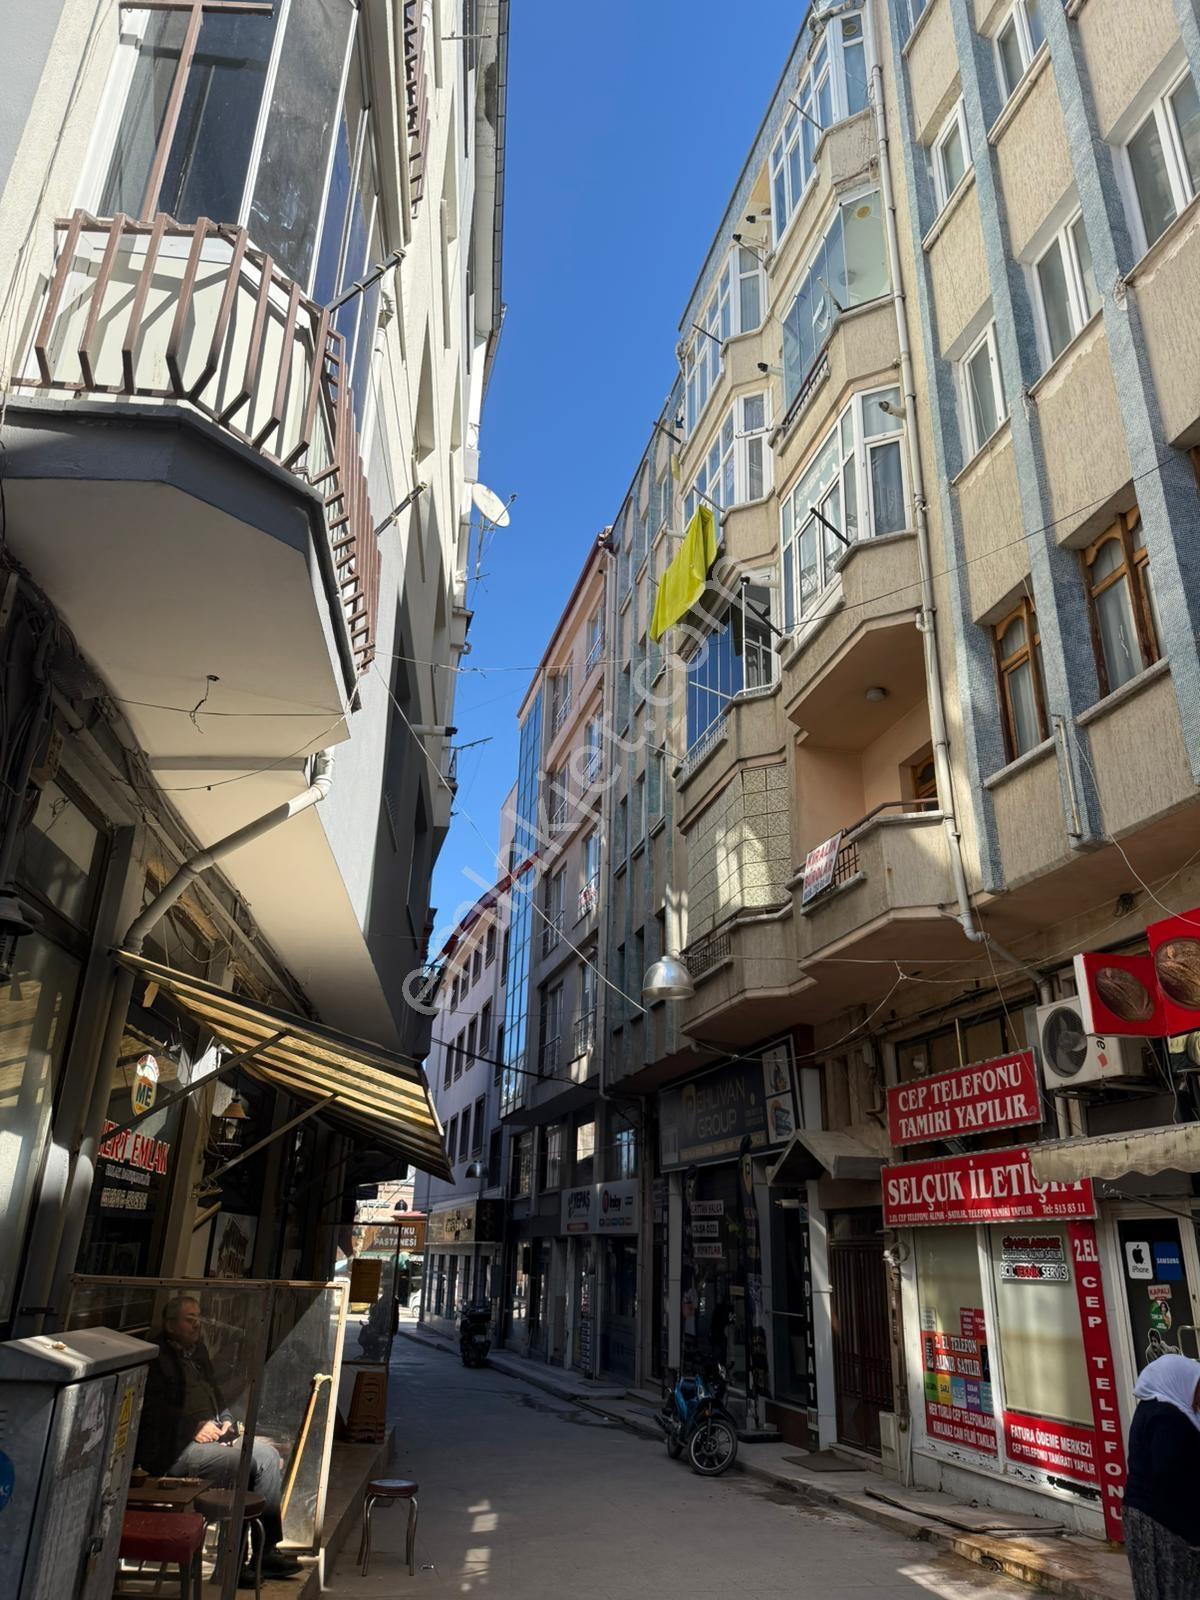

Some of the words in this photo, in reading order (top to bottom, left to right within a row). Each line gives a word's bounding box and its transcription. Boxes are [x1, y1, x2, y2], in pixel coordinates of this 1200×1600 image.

[136, 1083, 153, 1107] ME
[898, 1085, 927, 1112] CEP
[931, 1062, 1022, 1104] TELEFONU
[899, 1103, 951, 1140] TAMİRİ
[955, 1094, 1029, 1128] YAPILIR
[130, 1132, 170, 1176] EMLAK
[887, 1170, 965, 1211] SELÇUK
[1054, 1204, 1066, 1214] 513
[374, 1236, 417, 1247] PASTANESİ
[1074, 1239, 1099, 1261] 2.EL
[1041, 1264, 1067, 1279] SERVİS
[1156, 1257, 1179, 1265] SAMSUNG
[803, 1231, 815, 1400] TADİLAT
[1081, 1275, 1102, 1328] CEP
[951, 1337, 977, 1353] TELEFON
[952, 1408, 961, 1421] CEP
[1010, 1424, 1036, 1443] FATURA
[1035, 1428, 1060, 1449] ÖDEME
[1060, 1436, 1093, 1458] MERKEZİ
[1091, 1356, 1124, 1521] TELEFONU
[1012, 1443, 1021, 1454] CEP
[1022, 1445, 1048, 1461] TELEFONU
[1073, 1459, 1096, 1475] YAPILIR
